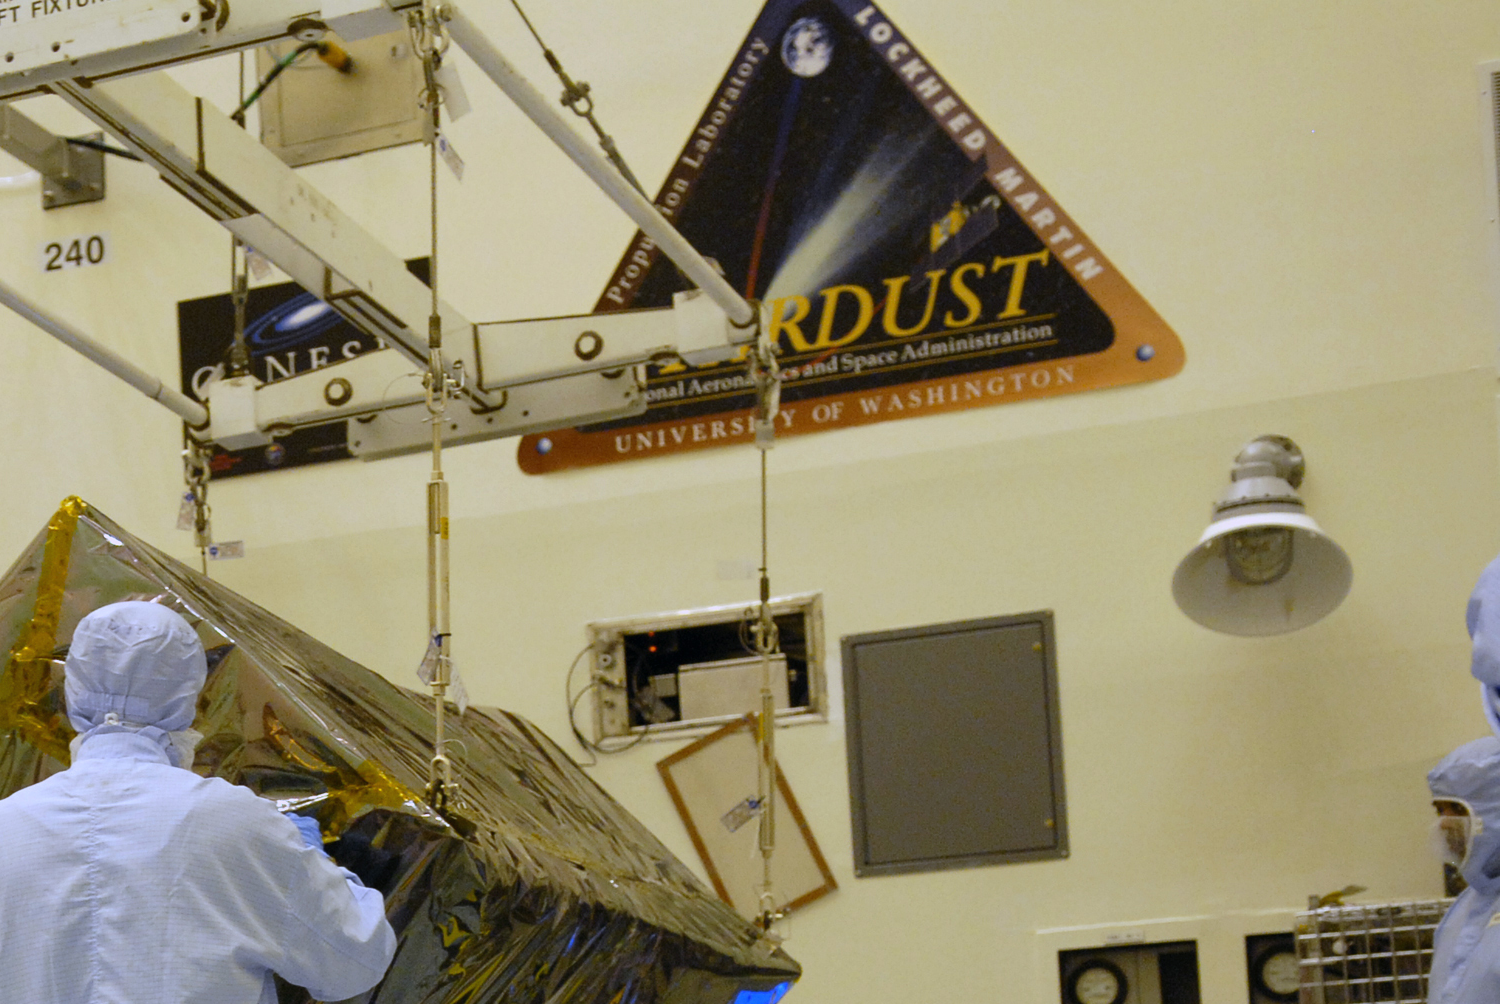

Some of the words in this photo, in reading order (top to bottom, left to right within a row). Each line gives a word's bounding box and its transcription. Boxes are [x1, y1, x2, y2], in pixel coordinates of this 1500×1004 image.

[31, 0, 111, 18] FIXT
[606, 178, 689, 305] Propuion
[683, 37, 770, 169] Laboratory
[854, 5, 987, 151] LOCKHEED
[994, 166, 1104, 281] MARTIN
[44, 235, 105, 271] 240
[658, 250, 1049, 375] RDUST
[646, 380, 685, 401] onal
[802, 355, 838, 378] and
[841, 348, 899, 374] Space
[901, 323, 1053, 360] Administration
[615, 408, 796, 454] UNIVERSIY
[812, 401, 845, 423] OF
[859, 365, 1076, 415] WASHINGTON
